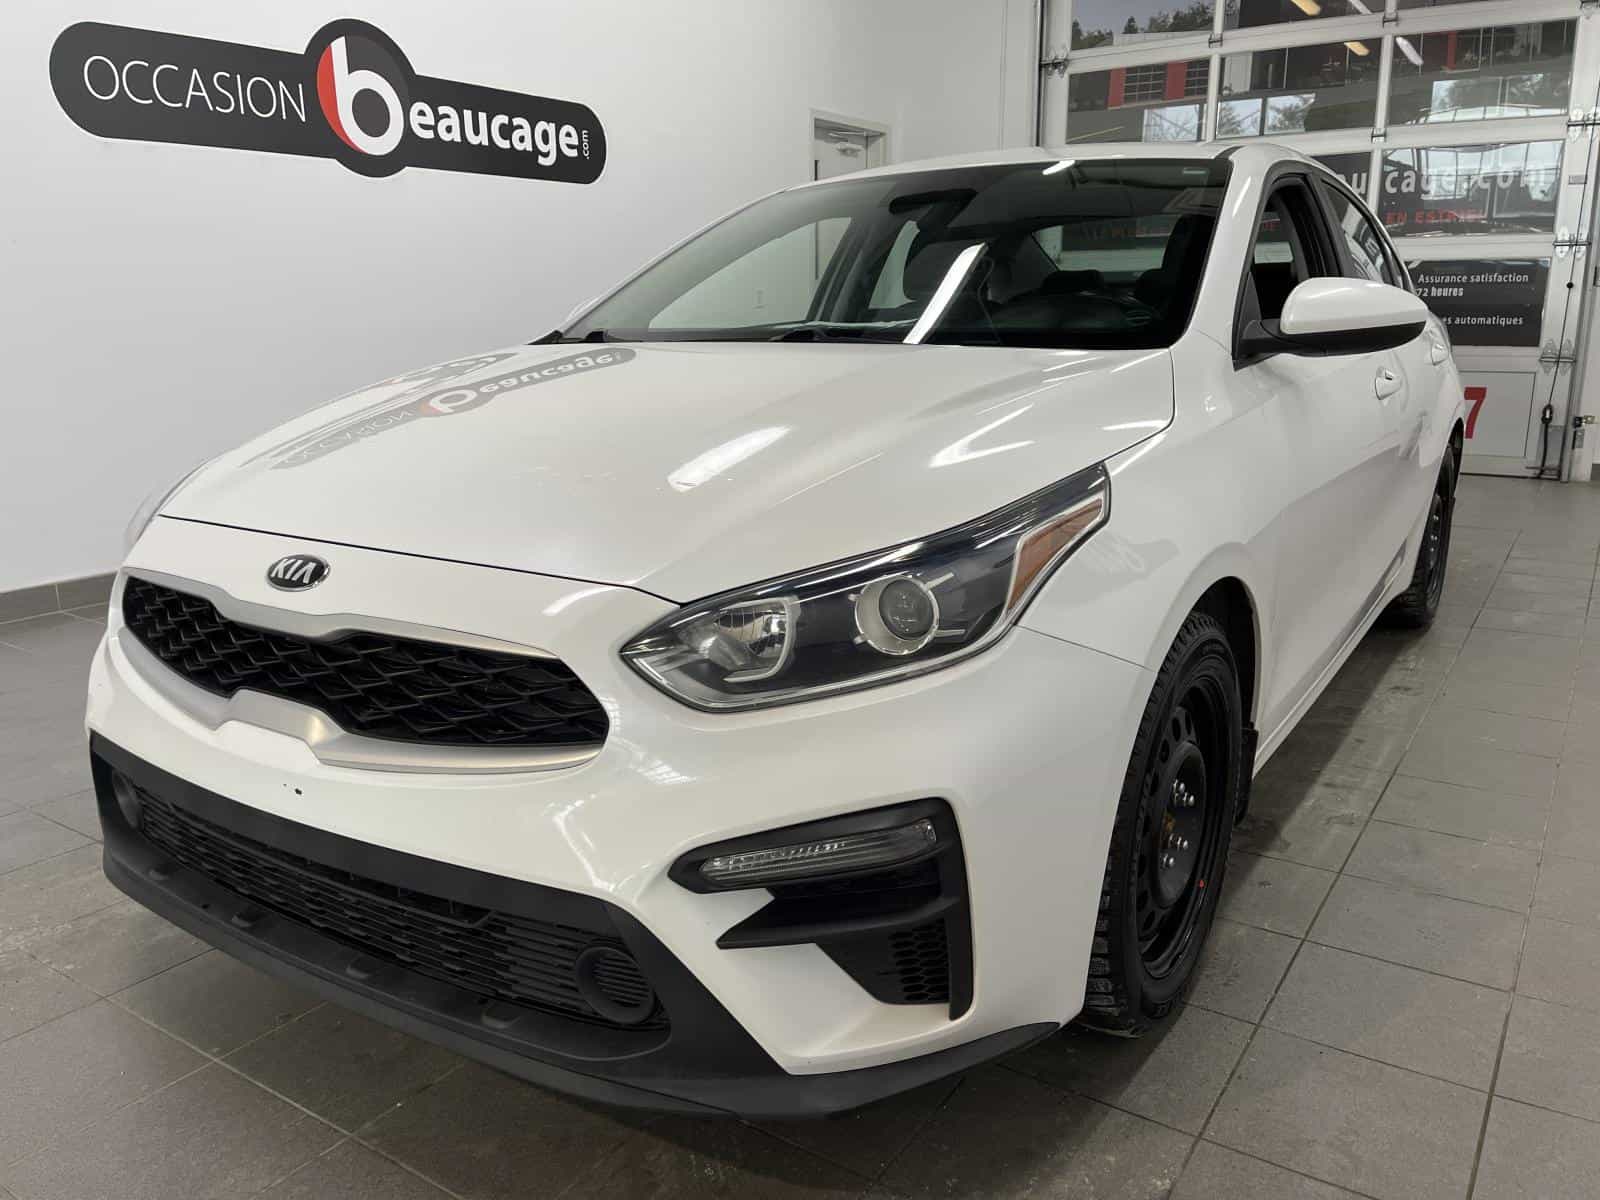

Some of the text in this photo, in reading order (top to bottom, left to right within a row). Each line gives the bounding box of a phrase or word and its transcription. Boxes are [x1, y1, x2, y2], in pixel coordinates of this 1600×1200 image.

[83, 35, 580, 167] OCCASION beaucage
[581, 129, 590, 160] .com
[1417, 272, 1529, 284] Assurance satisfaction
[1416, 286, 1464, 297] 72 heures
[1454, 315, 1524, 328] automatiques
[1464, 386, 1488, 440] 7
[270, 558, 317, 584] KIA
